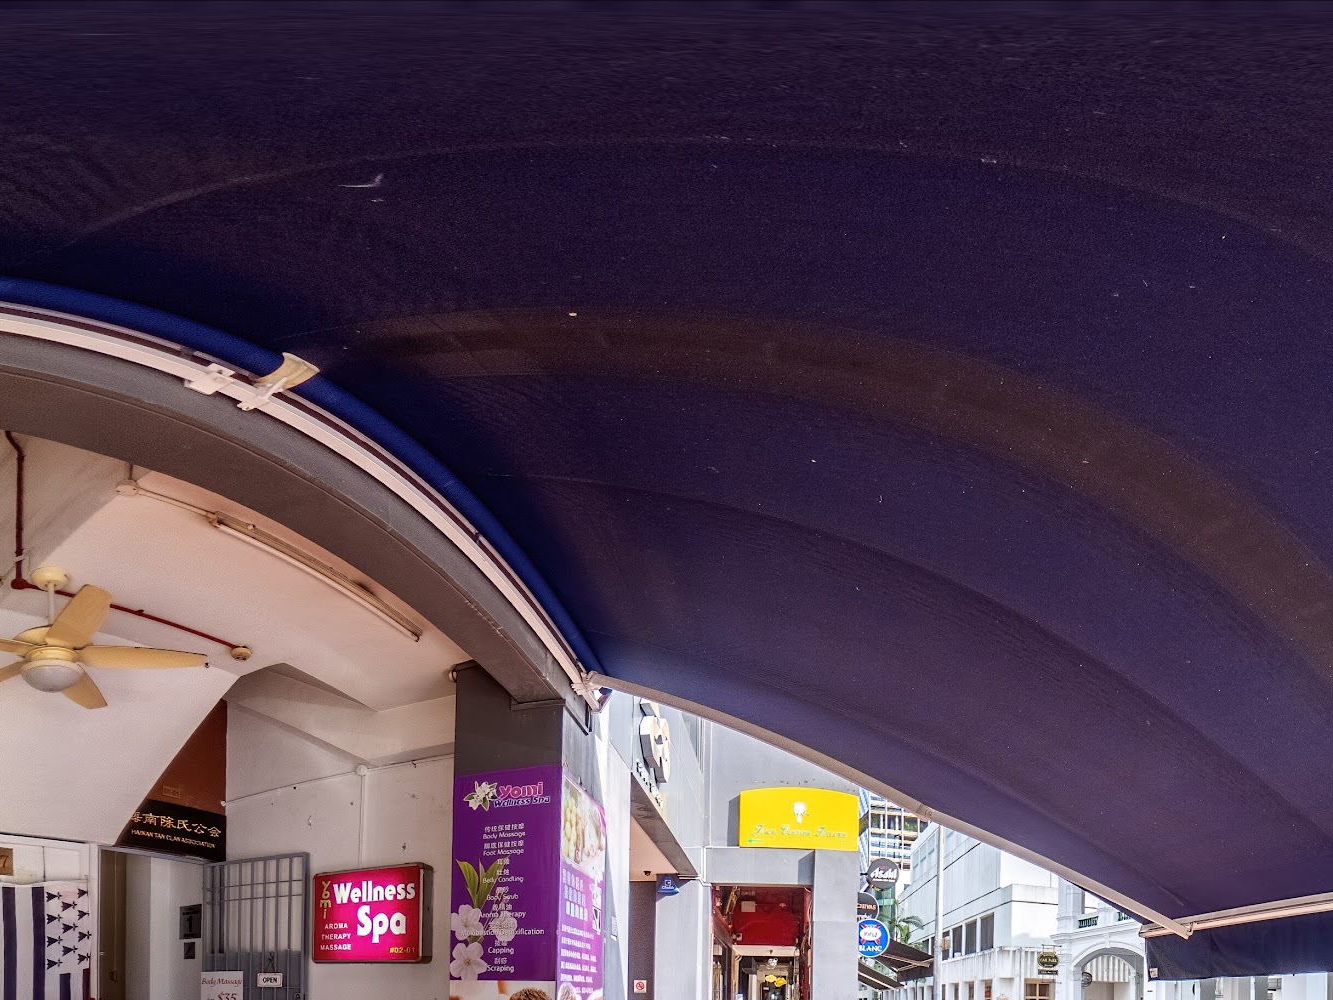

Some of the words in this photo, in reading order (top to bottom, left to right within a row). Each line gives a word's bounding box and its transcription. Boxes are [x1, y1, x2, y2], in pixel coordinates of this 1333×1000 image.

[493, 797, 531, 808] Wellness
[531, 795, 551, 805] Spa
[154, 832, 165, 840] TAN
[166, 834, 181, 842] CLAN
[497, 848, 525, 856] Massage
[333, 880, 416, 905] Wellness
[324, 922, 349, 930] AROMA
[356, 905, 406, 944] Spa
[321, 932, 352, 941] THERAPY
[320, 943, 352, 951] MASSAGE
[389, 946, 415, 954] #02-01
[487, 946, 515, 955] Capping
[486, 964, 515, 973] Scraping
[201, 977, 216, 987] Body
[216, 977, 243, 988] Massage
[262, 976, 278, 984] OPEN
